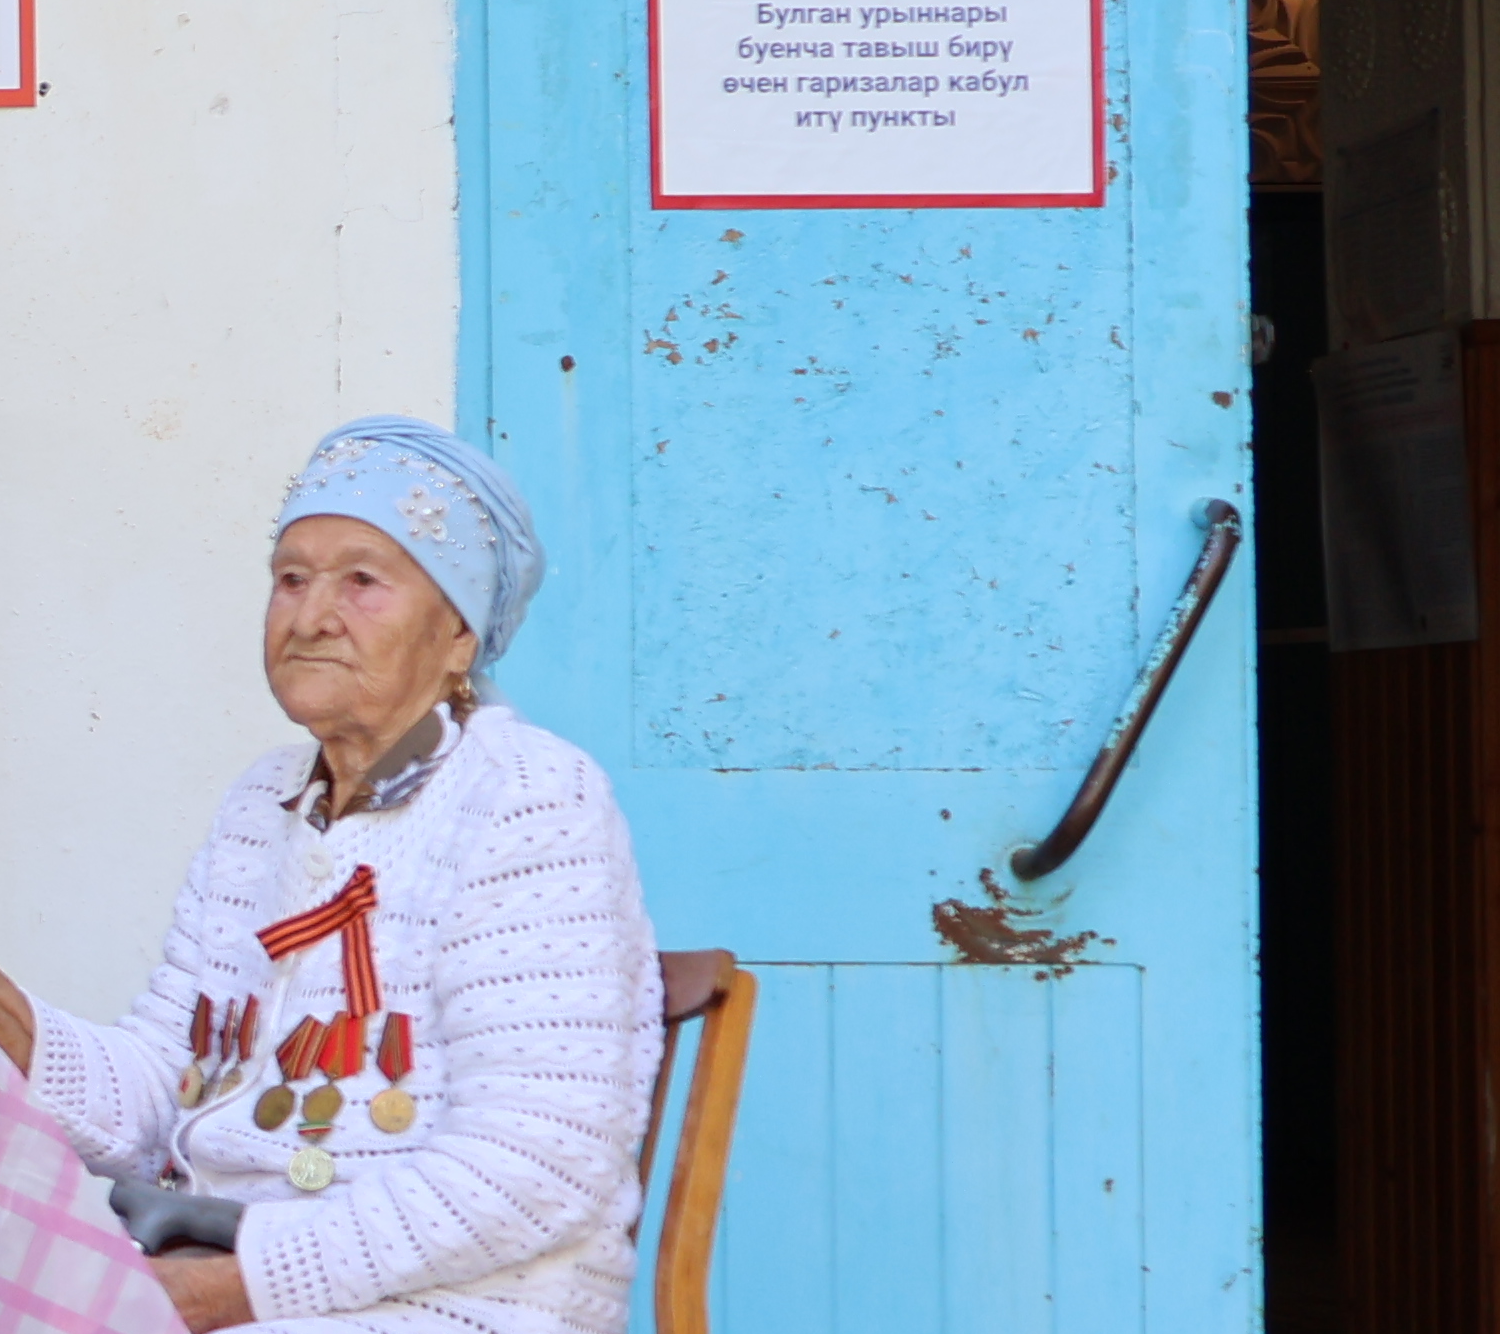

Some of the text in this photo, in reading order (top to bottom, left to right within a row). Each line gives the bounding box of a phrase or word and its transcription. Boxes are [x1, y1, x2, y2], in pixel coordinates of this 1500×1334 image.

[756, 3, 1007, 29] Булган урыннары
[738, 35, 1014, 64] буенча тавыш бирү
[722, 70, 1029, 97] өчен гаризалар кабул
[795, 108, 956, 132] итү пункты
